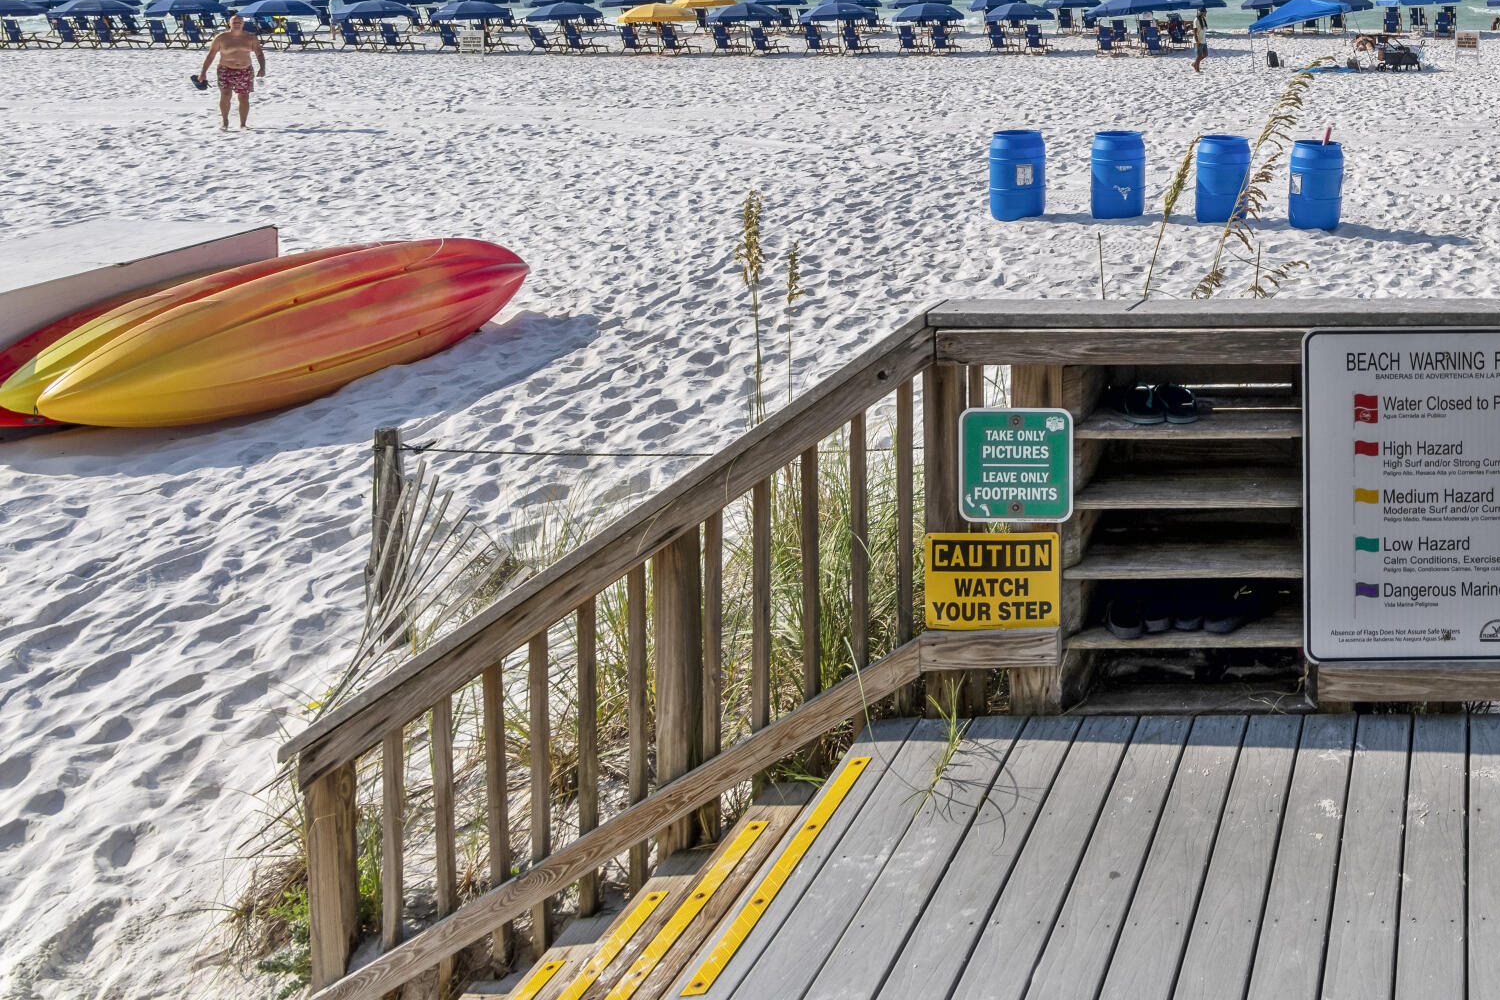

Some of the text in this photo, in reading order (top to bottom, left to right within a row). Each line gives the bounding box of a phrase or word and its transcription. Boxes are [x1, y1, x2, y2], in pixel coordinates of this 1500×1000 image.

[1346, 352, 1400, 372] BEACH
[1410, 352, 1485, 371] WARNING
[1383, 396, 1422, 411] Water
[1426, 395, 1472, 411] Closed
[1476, 397, 1489, 410] to
[985, 430, 1046, 441] TAKE ONLY
[982, 445, 1049, 459] PICTURES
[1383, 440, 1463, 460] High Hazard
[1383, 459, 1402, 470] High
[1404, 459, 1422, 468] Surf
[1424, 458, 1450, 468] and/or
[1453, 458, 1480, 469] Strong
[983, 471, 1049, 483] LEAVE ONLY
[974, 486, 1058, 501] FOOTPRINTS
[1383, 488, 1494, 504] Medium Hazard
[1383, 506, 1426, 515] Moderate
[1428, 505, 1448, 514] Surf
[1450, 505, 1480, 514] and/or
[1383, 536, 1470, 552] Low Hazard
[934, 544, 1050, 567] CAUTION
[1383, 556, 1407, 565] Calm
[1410, 555, 1460, 565] Conditions,
[954, 577, 1029, 598] WATCH
[1383, 582, 1457, 600] Dangerous
[932, 601, 1052, 622] YOUR STEP
